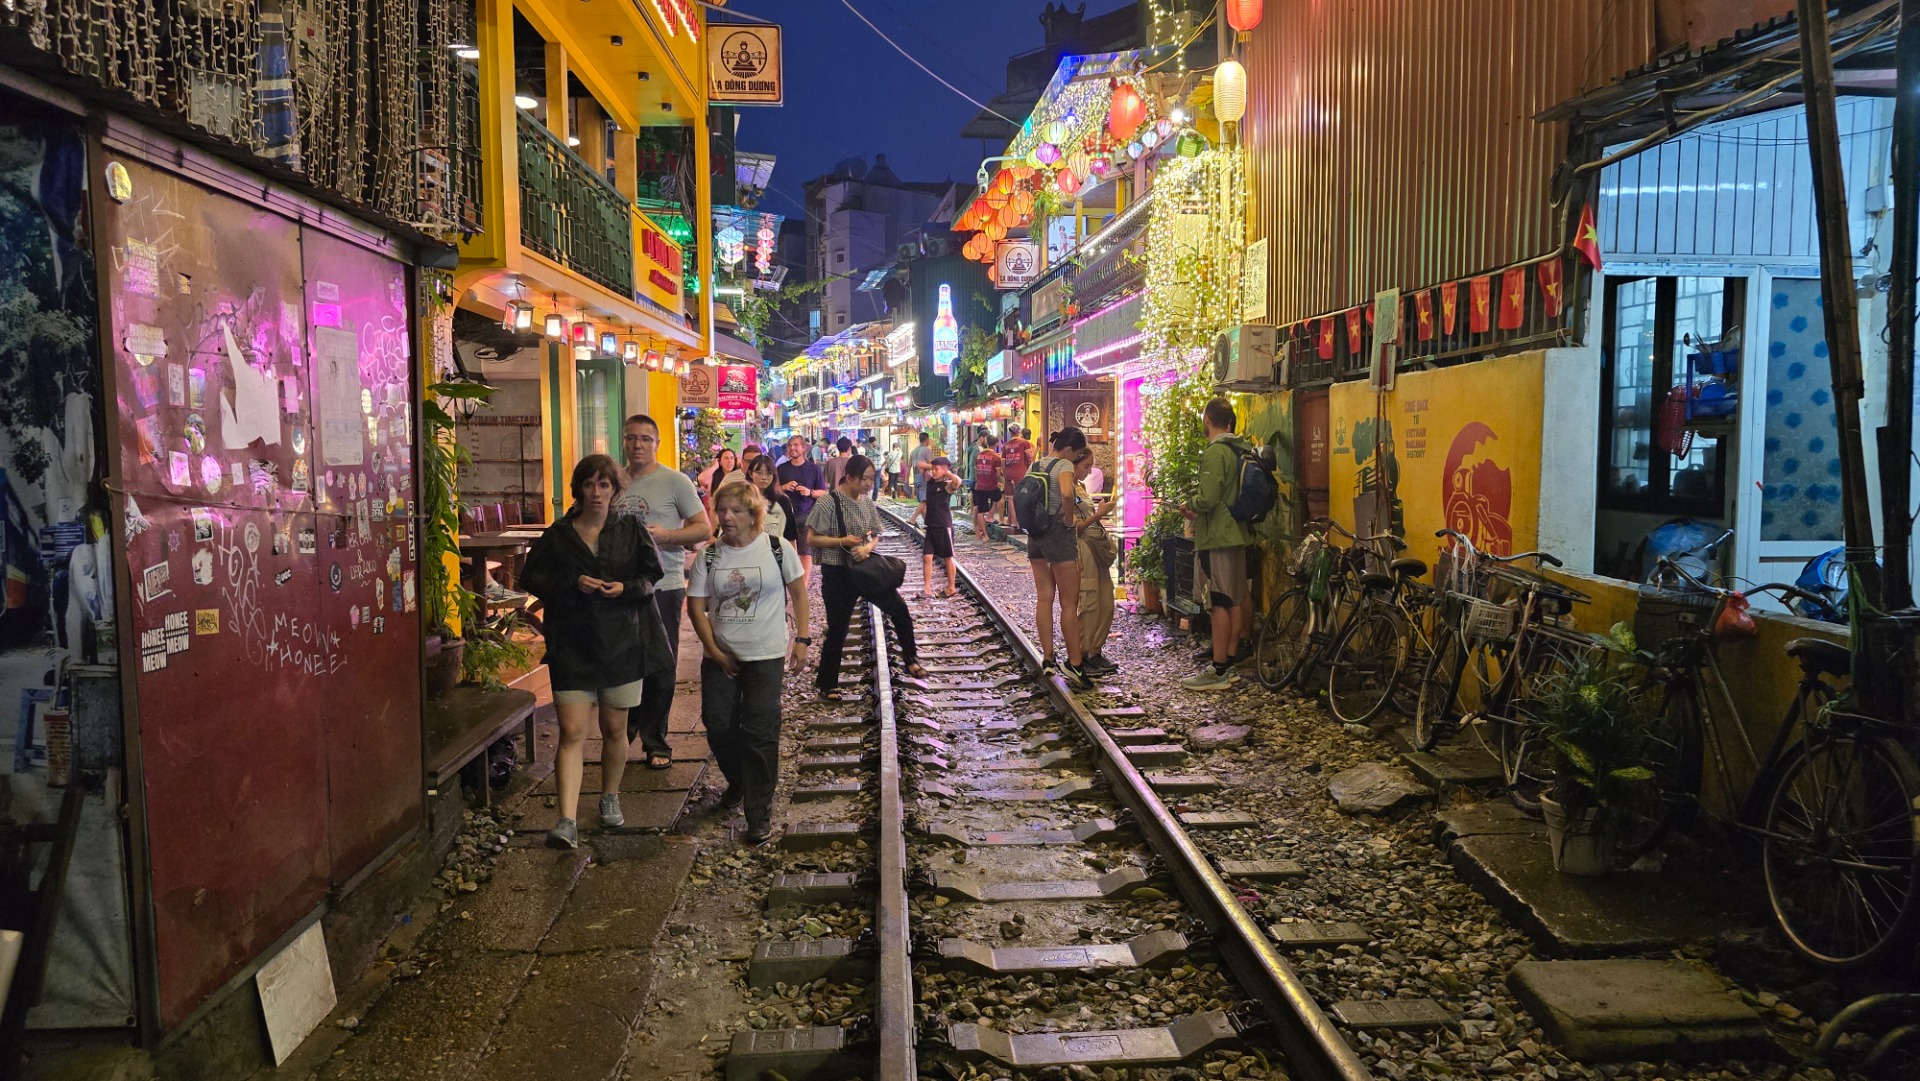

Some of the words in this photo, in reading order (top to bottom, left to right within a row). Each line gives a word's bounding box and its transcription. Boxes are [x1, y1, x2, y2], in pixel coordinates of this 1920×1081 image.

[725, 79, 746, 91] ĐÔNG
[748, 79, 775, 91] DƯƠNG
[1413, 414, 1420, 425] TO
[1406, 449, 1425, 459] HISTORY
[165, 611, 188, 631] HONEE
[142, 627, 165, 648] HONEE
[274, 612, 331, 654] MEOW
[166, 634, 189, 655] MEOW
[143, 652, 167, 673] MEOW
